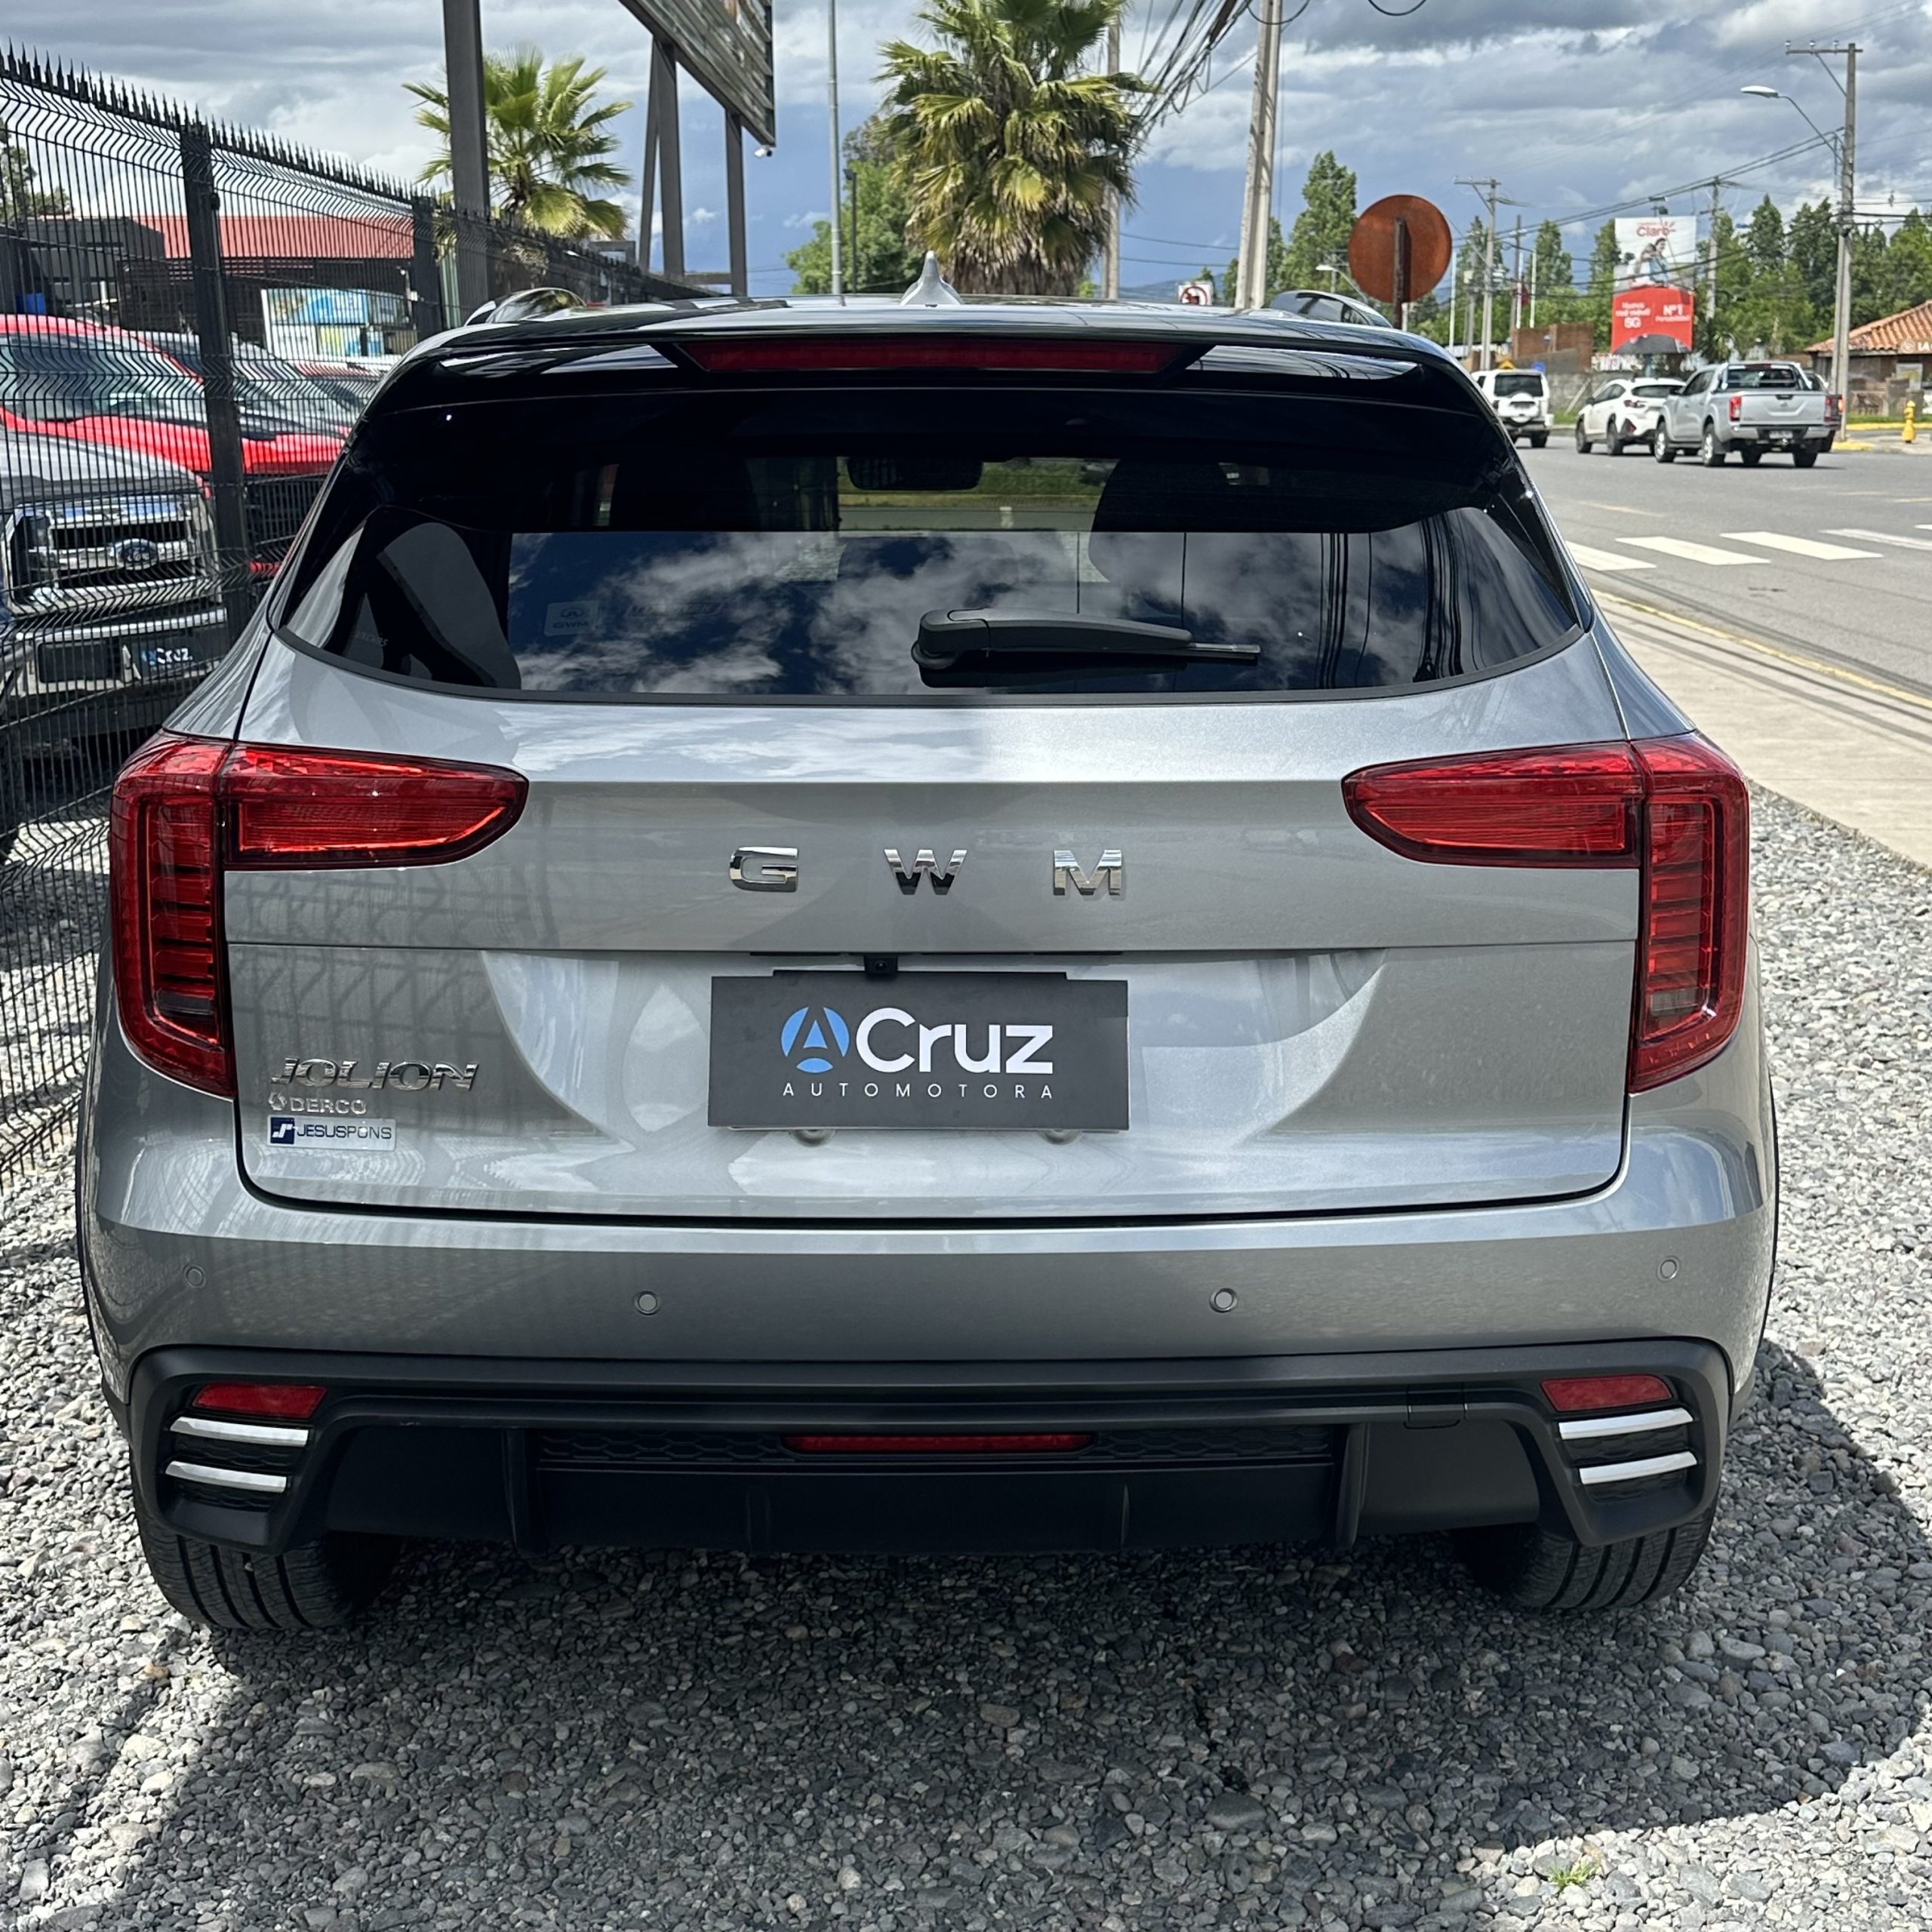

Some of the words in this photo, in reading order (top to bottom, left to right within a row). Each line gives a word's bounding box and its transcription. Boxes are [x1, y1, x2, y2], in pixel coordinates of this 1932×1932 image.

[1636, 226, 1669, 237] Claro
[552, 620, 589, 629] GWM
[271, 1057, 479, 1091] JOLION
[783, 1081, 1053, 1100] AUTOMOTORA
[290, 1097, 367, 1115] DERCO
